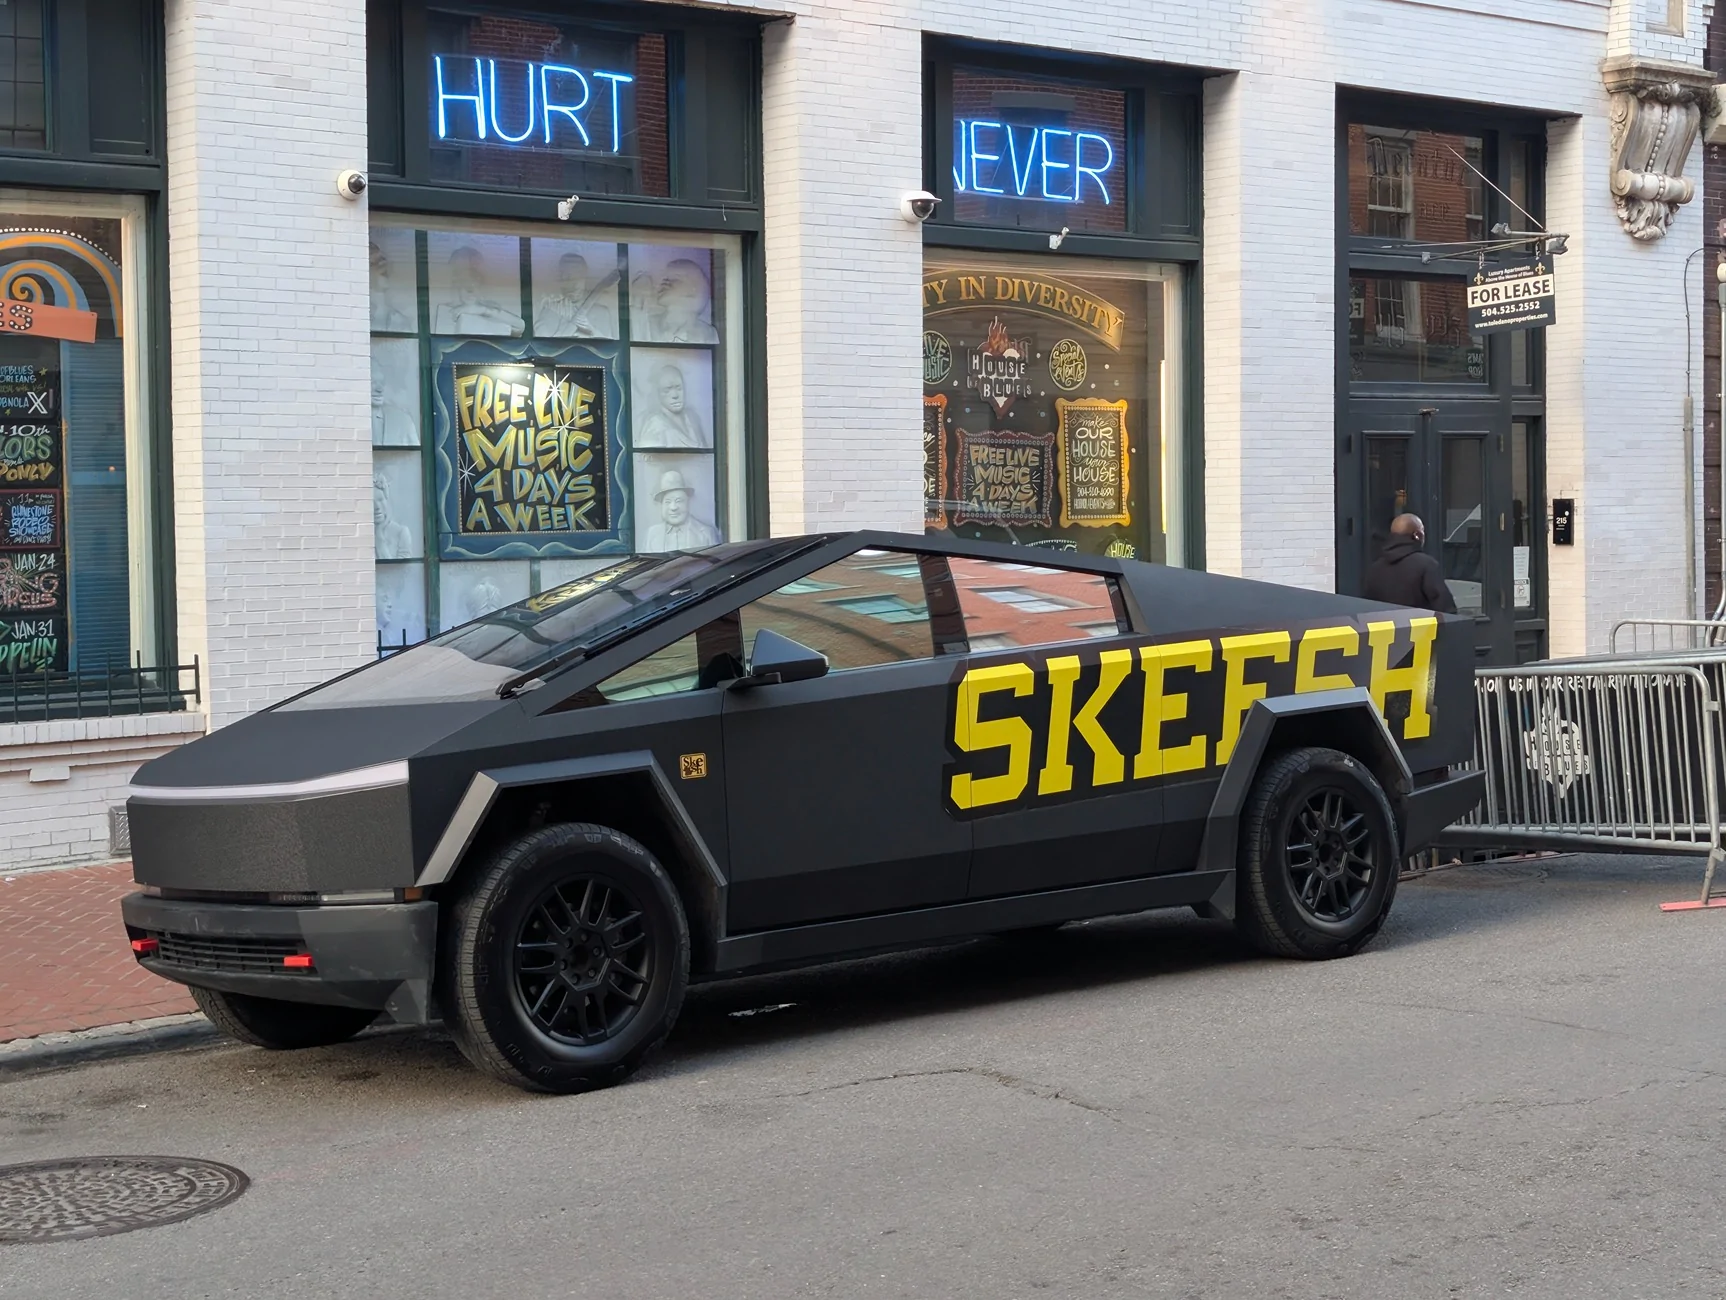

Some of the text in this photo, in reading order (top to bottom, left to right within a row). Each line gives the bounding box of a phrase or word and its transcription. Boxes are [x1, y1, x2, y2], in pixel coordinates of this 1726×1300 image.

[435, 55, 633, 153] HURT
[1504, 265, 1531, 274] Apartments
[1471, 279, 1550, 305] FOR LEASE
[958, 276, 987, 300] IN
[994, 276, 1122, 337] DIVERSITY
[1481, 301, 1540, 317] 504.525.2552
[971, 354, 1026, 375] HOUSE
[983, 383, 1032, 398] BLUES
[457, 373, 596, 431] FREE LIVE
[1076, 427, 1113, 439] OUR
[463, 424, 593, 473] MUSIC
[969, 444, 1039, 466] FREE LIVE
[1072, 440, 1116, 458] HOUSE
[6, 462, 55, 481] ONLY
[974, 465, 1030, 484] MUSIC
[1073, 466, 1116, 482] HOUSE
[474, 468, 596, 505] 4 DAYS
[972, 482, 1033, 501] 4 DAYS
[12, 505, 55, 518] RHINESTONE
[982, 496, 1038, 514] WEEK
[466, 498, 597, 533] A WEEK
[1111, 543, 1135, 559] HOUSE
